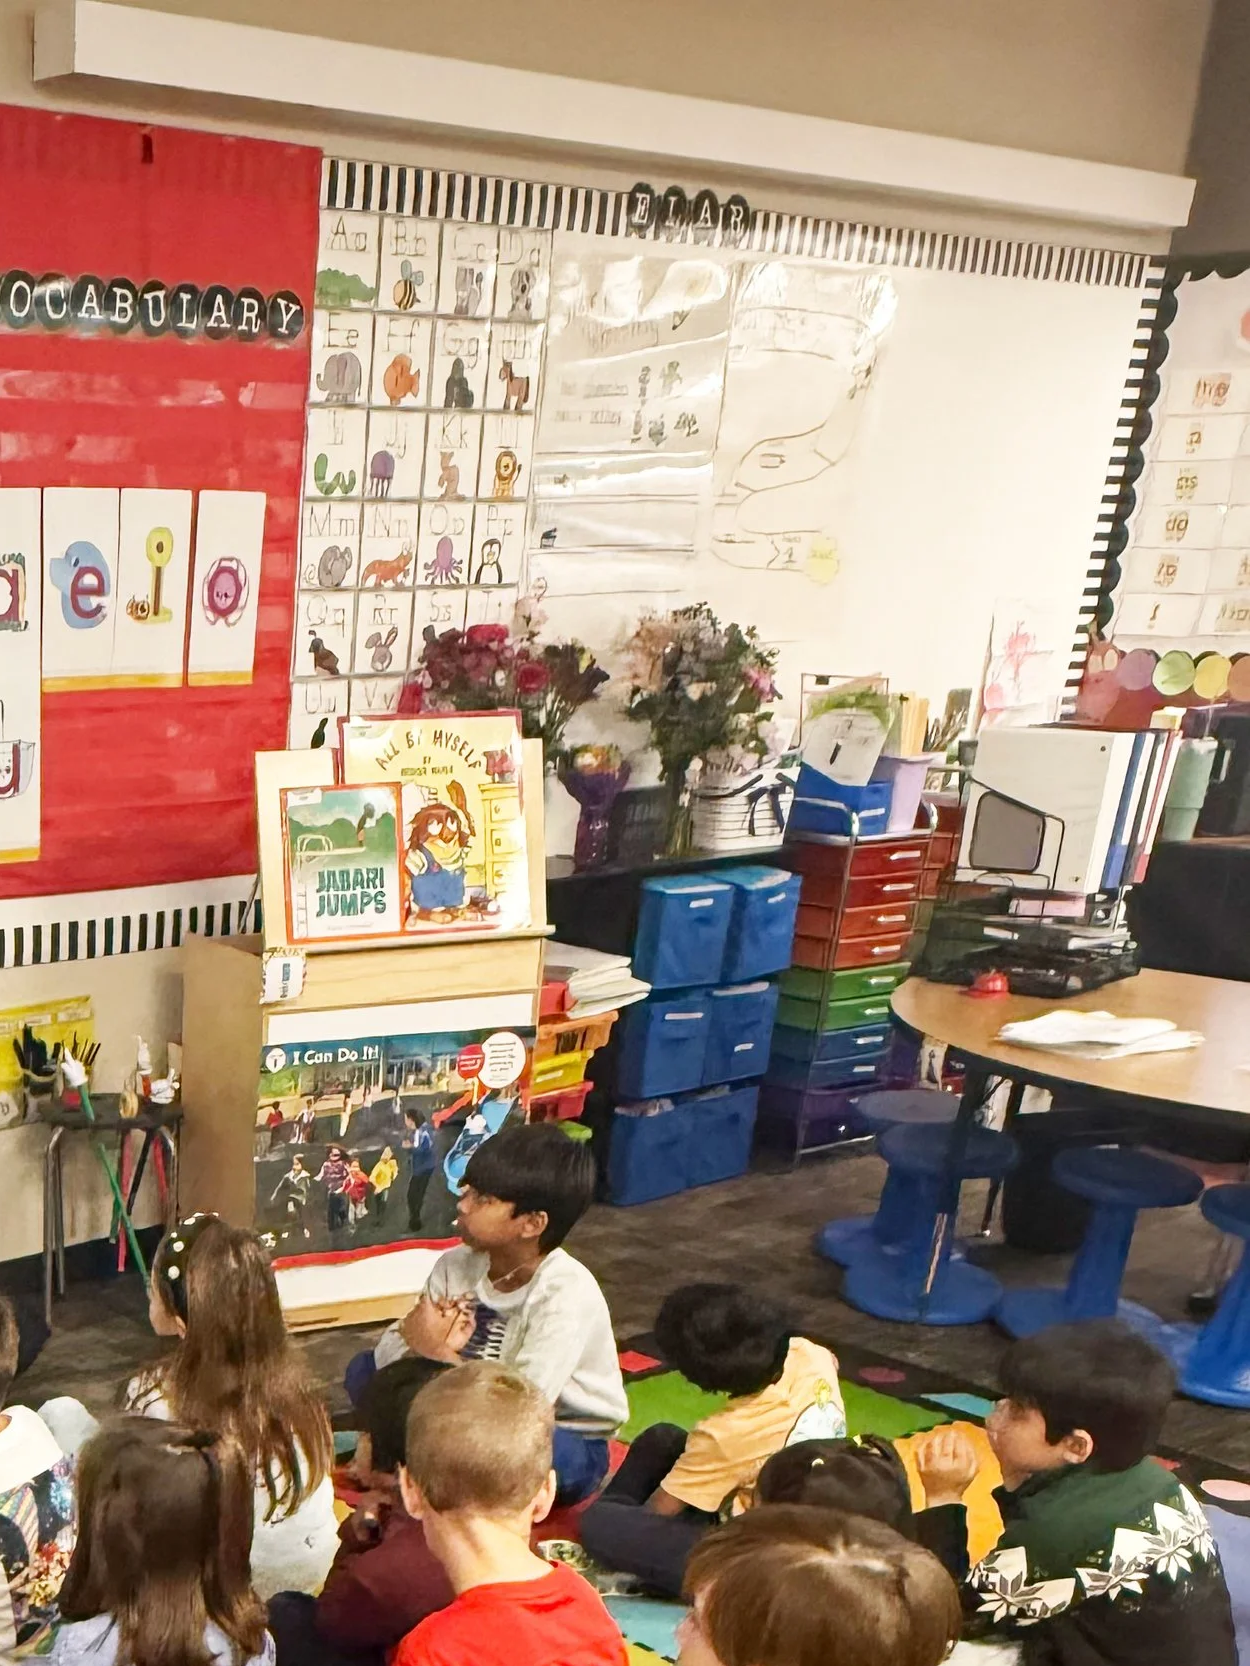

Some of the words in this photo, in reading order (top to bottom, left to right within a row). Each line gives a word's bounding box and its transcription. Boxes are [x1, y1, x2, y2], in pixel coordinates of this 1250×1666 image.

[323, 311, 359, 349] Ee
[68, 563, 107, 620] e
[316, 890, 387, 918] JUMPS
[304, 1049, 333, 1065] Can
[337, 1047, 359, 1063] Do
